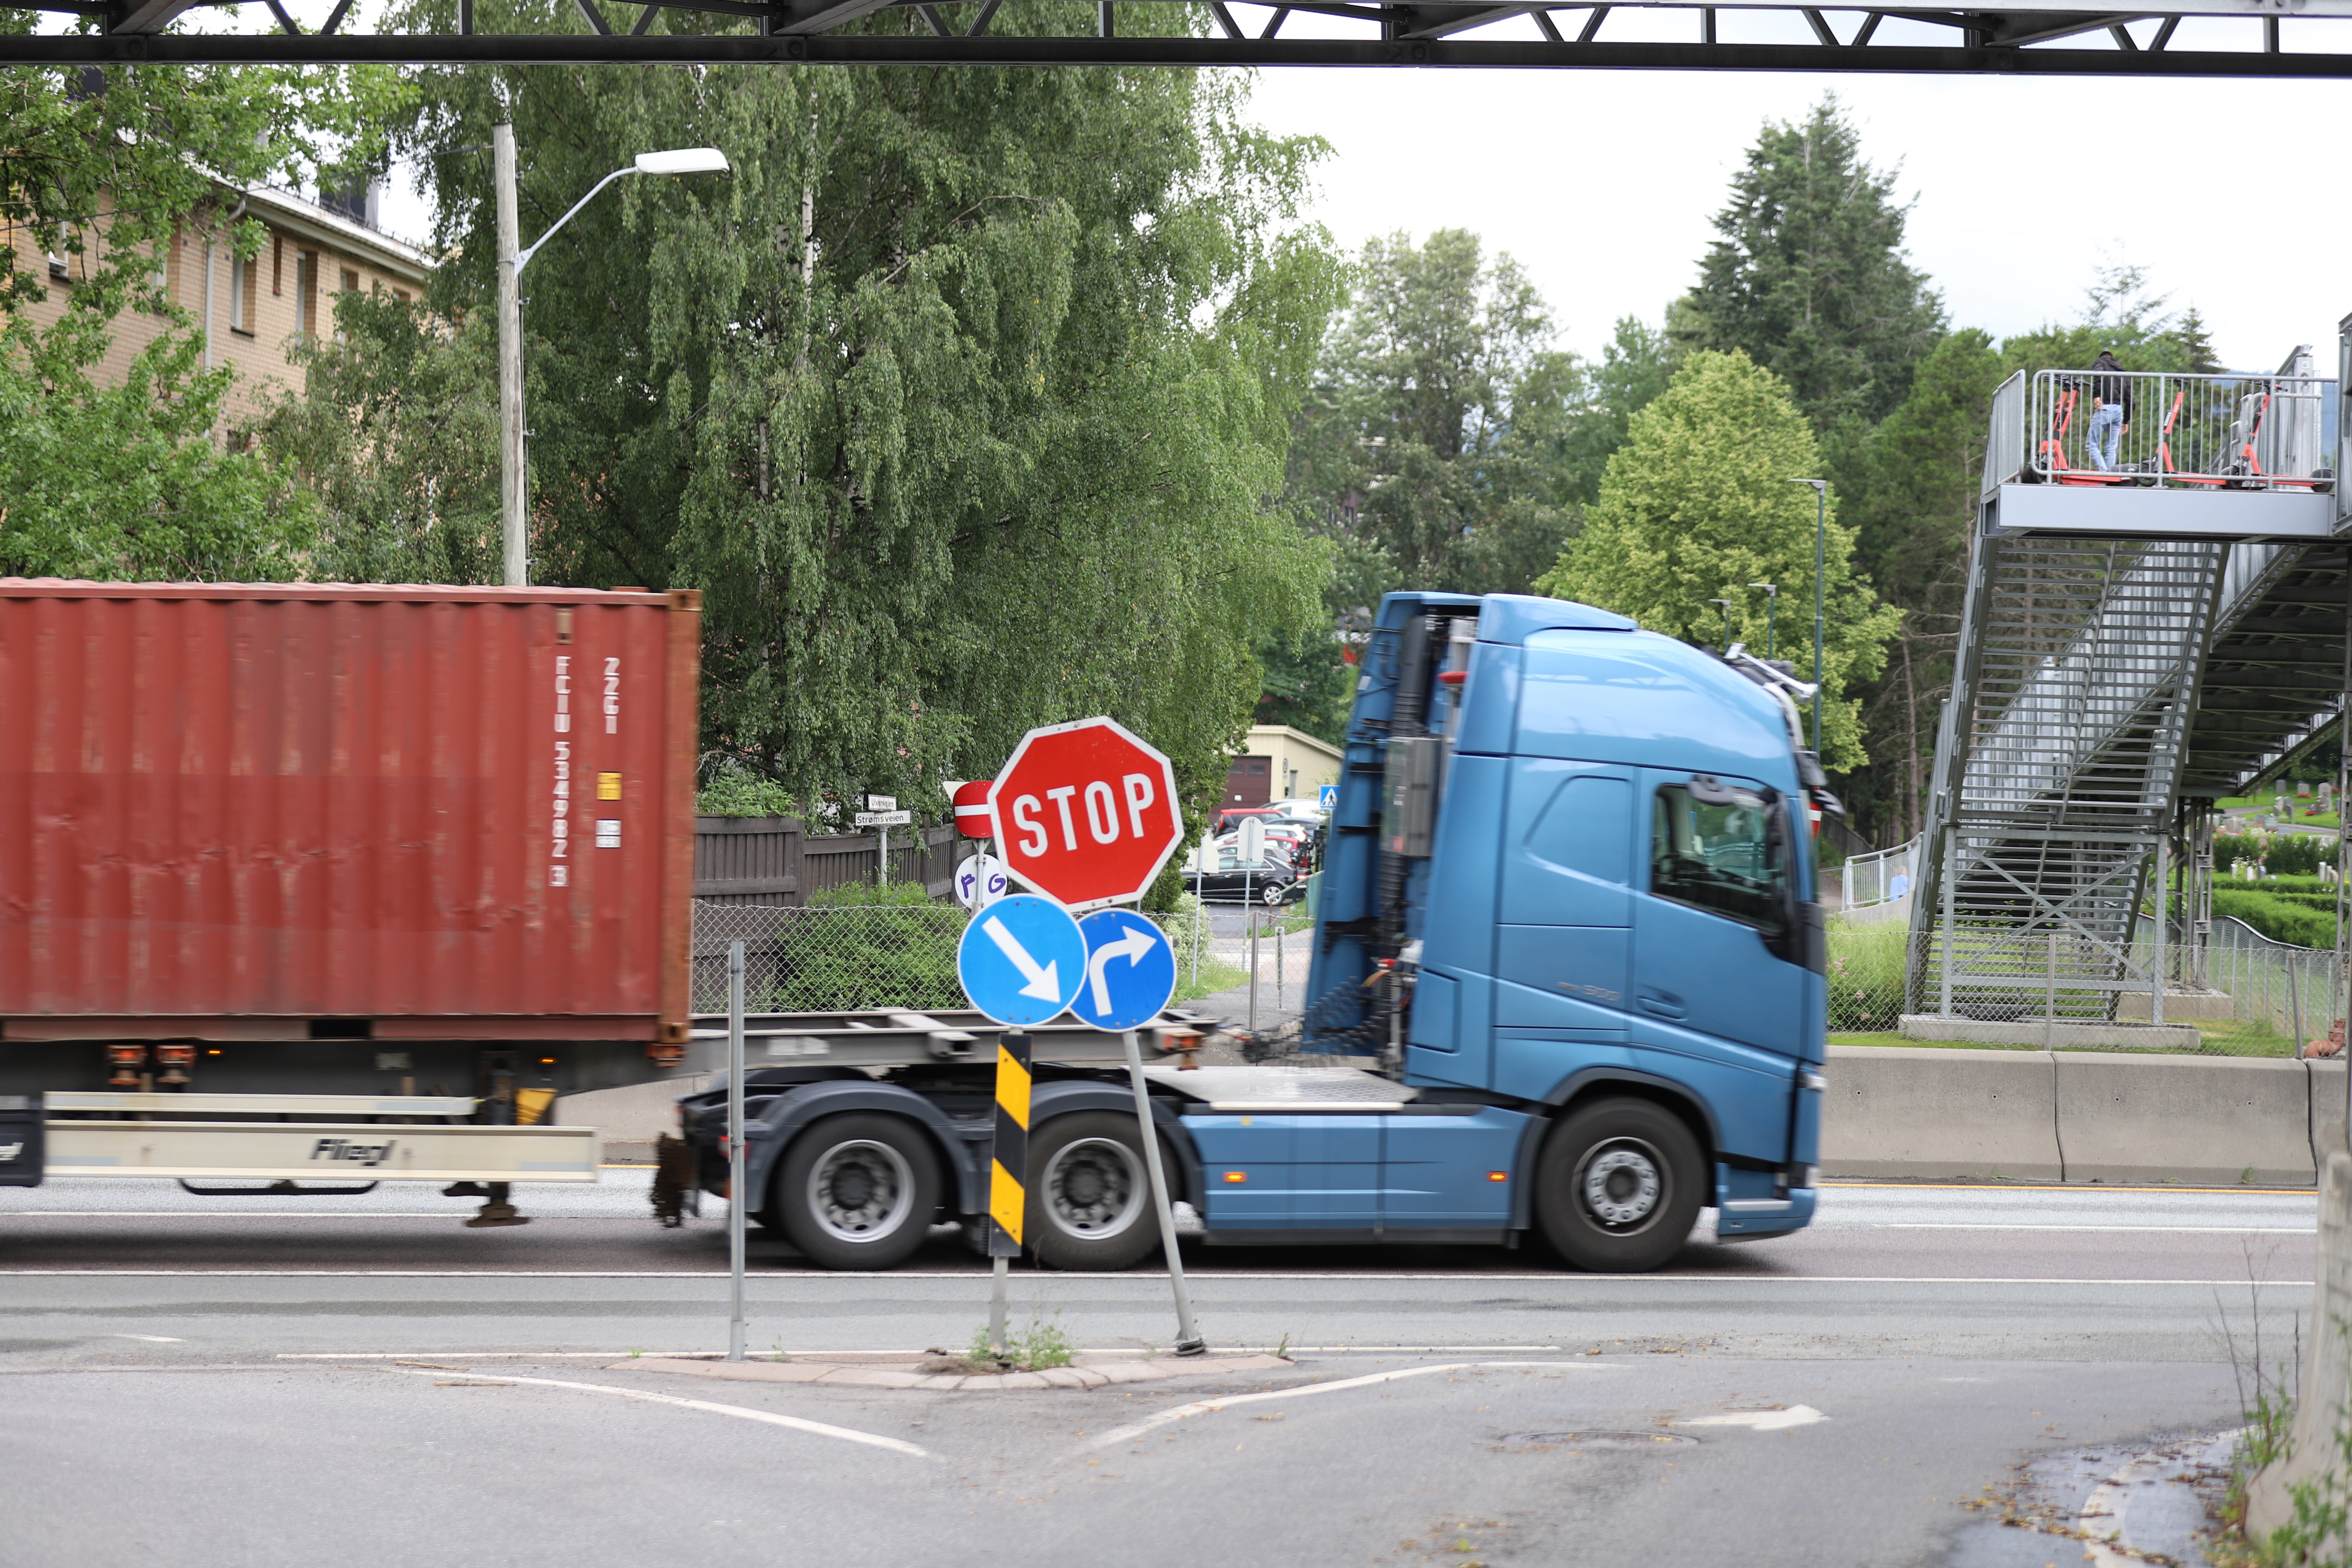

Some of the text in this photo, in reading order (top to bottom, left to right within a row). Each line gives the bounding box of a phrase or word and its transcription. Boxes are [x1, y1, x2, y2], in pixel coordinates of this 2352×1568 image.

[603, 657, 620, 734] 22G1
[551, 656, 571, 885] FCIU 534982 3
[871, 798, 894, 807] Ulvenveien
[1012, 773, 1154, 858] STOP
[857, 814, 903, 824] Strømsveien
[988, 873, 1006, 893] G
[308, 1138, 398, 1166] Fliegl
